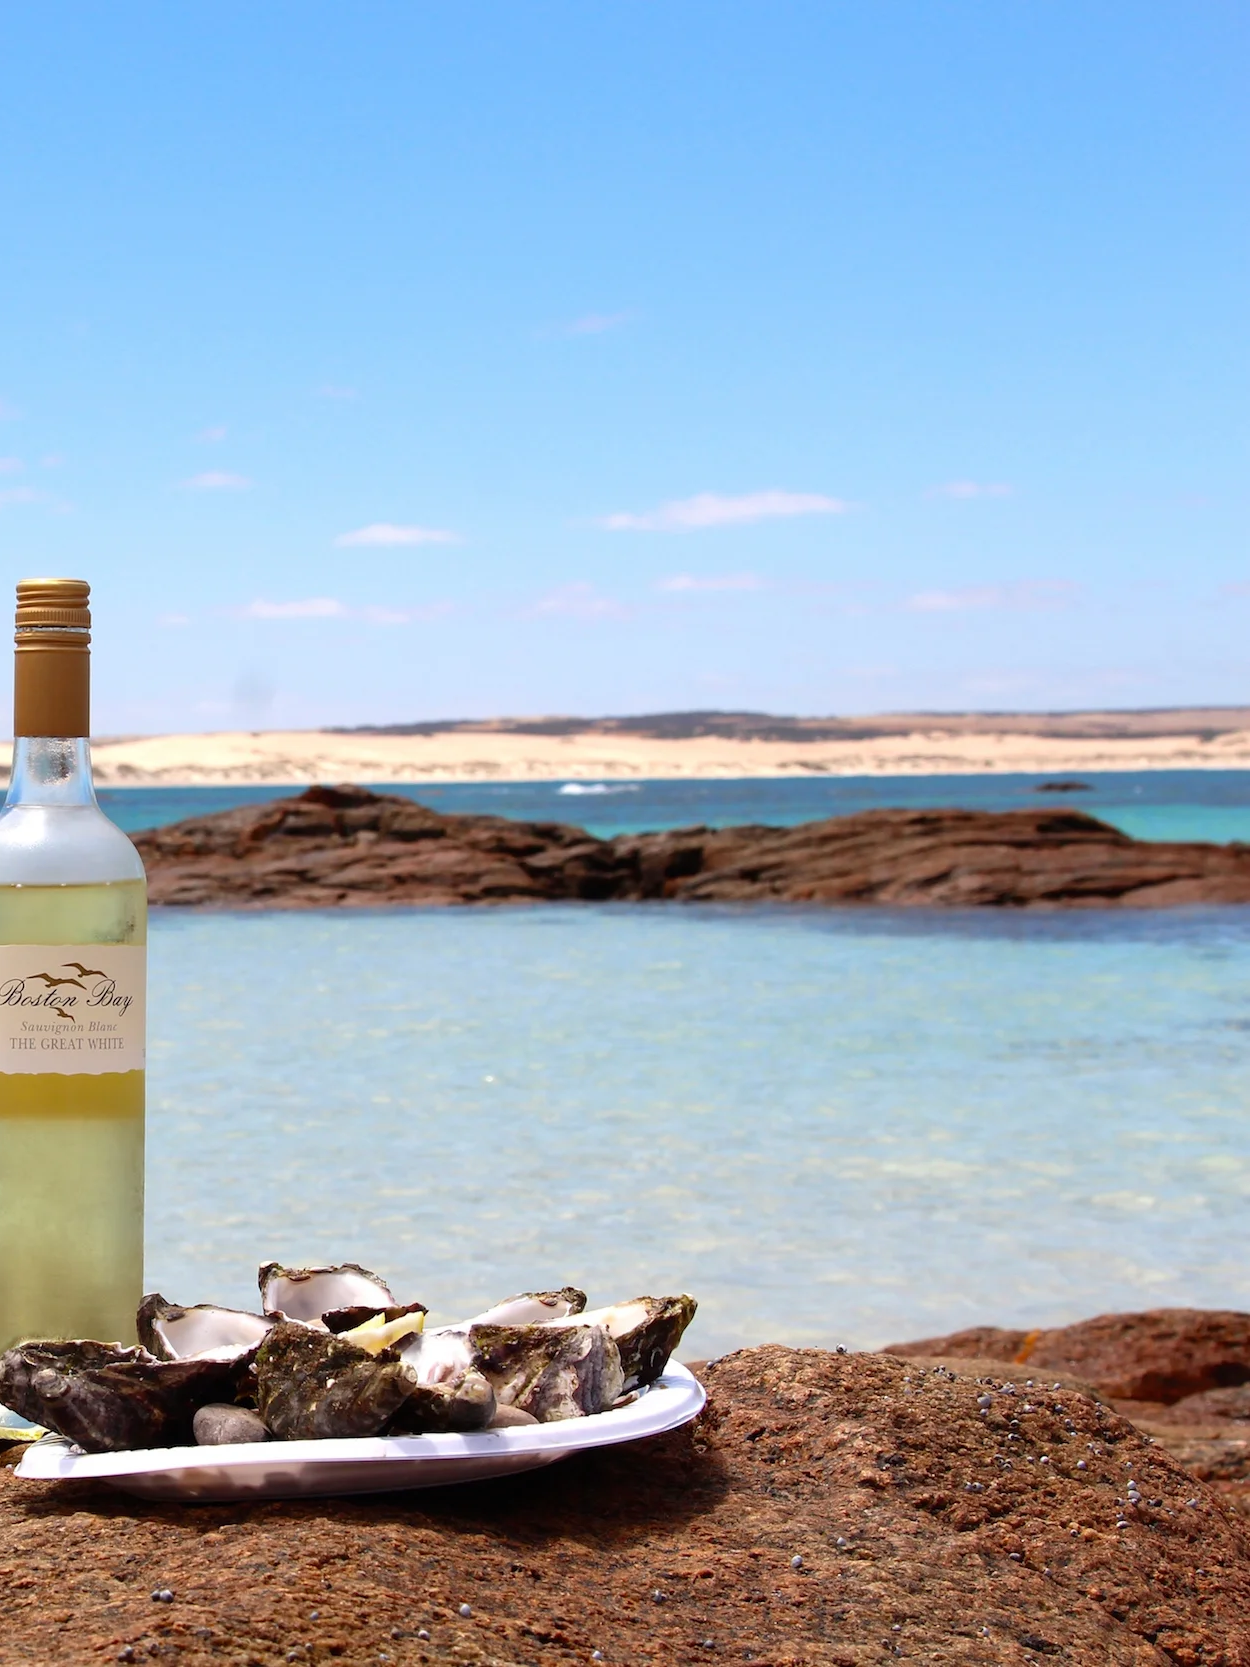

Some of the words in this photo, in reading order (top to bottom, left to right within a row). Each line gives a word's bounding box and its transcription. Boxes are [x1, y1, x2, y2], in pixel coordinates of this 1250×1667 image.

[86, 978, 134, 1017] Bay
[20, 1021, 84, 1035] Sauvignon
[88, 1021, 118, 1032] Blanc
[9, 1037, 36, 1050] THE
[40, 1037, 84, 1050] GREAT
[87, 1037, 125, 1050] WHITE
